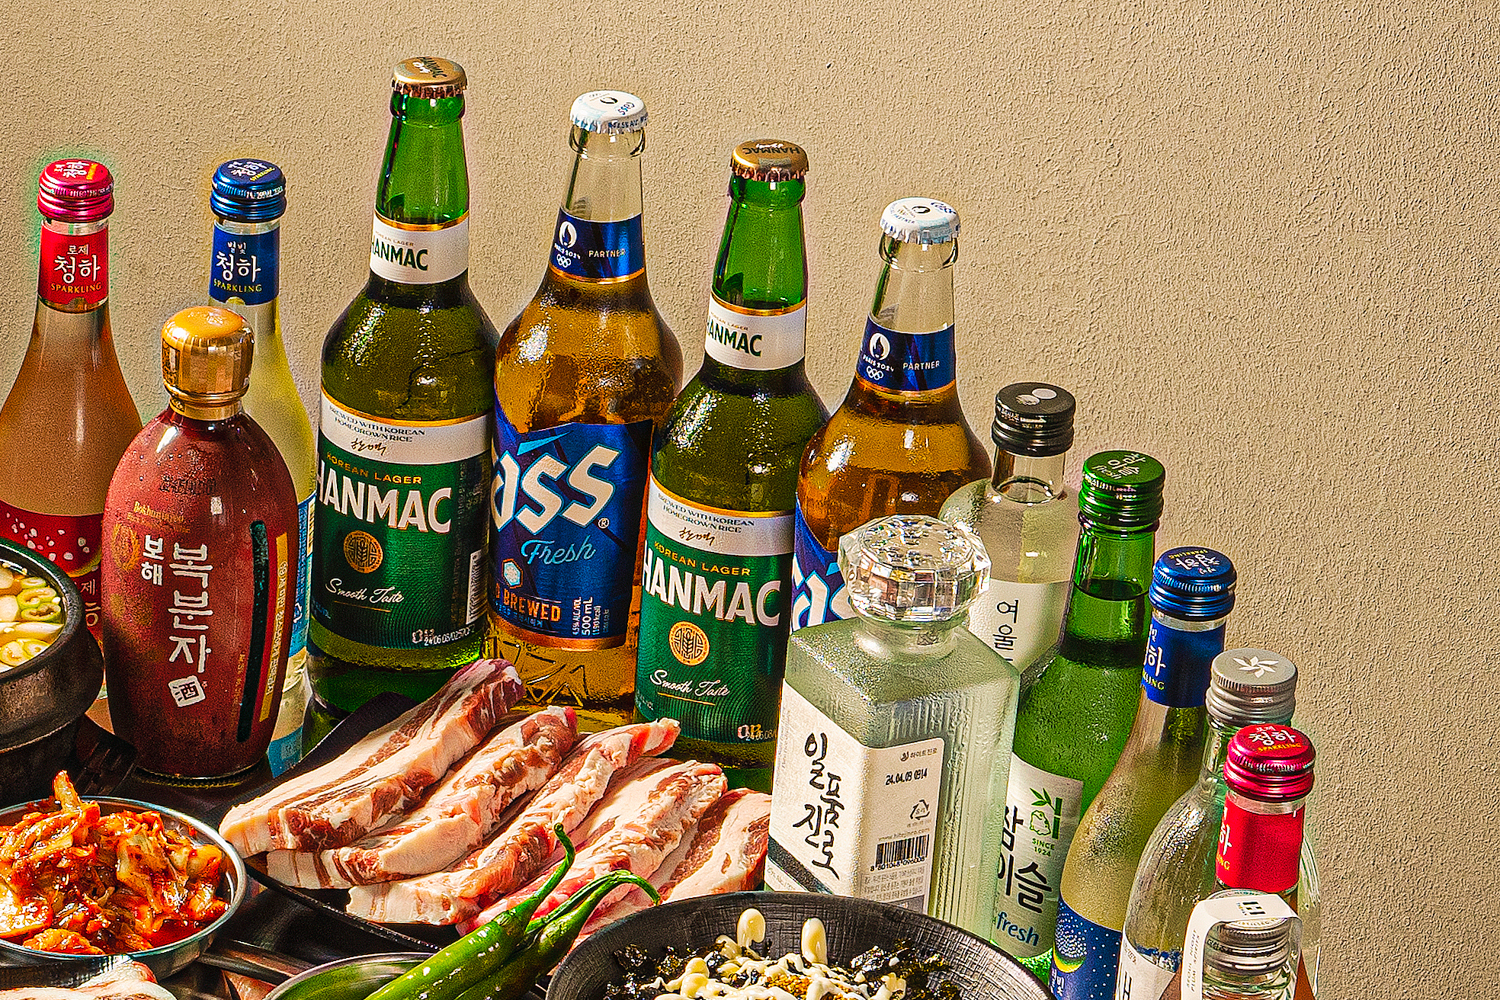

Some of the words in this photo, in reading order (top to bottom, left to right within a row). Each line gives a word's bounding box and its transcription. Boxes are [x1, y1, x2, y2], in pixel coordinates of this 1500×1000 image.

[67, 244, 90, 256] 로제
[227, 241, 248, 256] 별빛
[588, 248, 626, 258] PARTNER
[54, 254, 102, 284] 청하
[215, 252, 262, 283] 청하
[50, 282, 102, 294] SPARKLING
[213, 279, 263, 293] SPARKLING
[902, 360, 940, 371] PARTNER
[359, 420, 384, 432] WITH
[385, 425, 426, 436] KOREAN
[389, 434, 413, 443] RICE
[327, 451, 369, 477] KOREAN
[374, 472, 422, 485] LAGER
[491, 443, 622, 535] ass
[688, 509, 712, 521] WITH
[713, 515, 755, 526] KOREAN
[718, 525, 742, 533] RICE
[141, 535, 164, 586] 보해
[520, 535, 597, 565] Fresh
[654, 541, 696, 568] KOREAN
[701, 562, 751, 576] LAGER
[325, 577, 367, 602] Smooth
[369, 586, 405, 604] Taste
[642, 540, 782, 627] HANMAC
[168, 541, 214, 674] 복분자
[503, 588, 561, 622] BREWED
[582, 596, 593, 614] mL
[581, 615, 592, 636] 500
[992, 599, 1019, 651] 여울
[650, 668, 693, 694] Smooth
[695, 679, 730, 697] Taste
[1248, 729, 1297, 746] 청하
[1032, 837, 1056, 852] SINCE
[1034, 846, 1052, 857] 1924
[997, 853, 1053, 914] 이슬
[996, 911, 1040, 947] fresh
